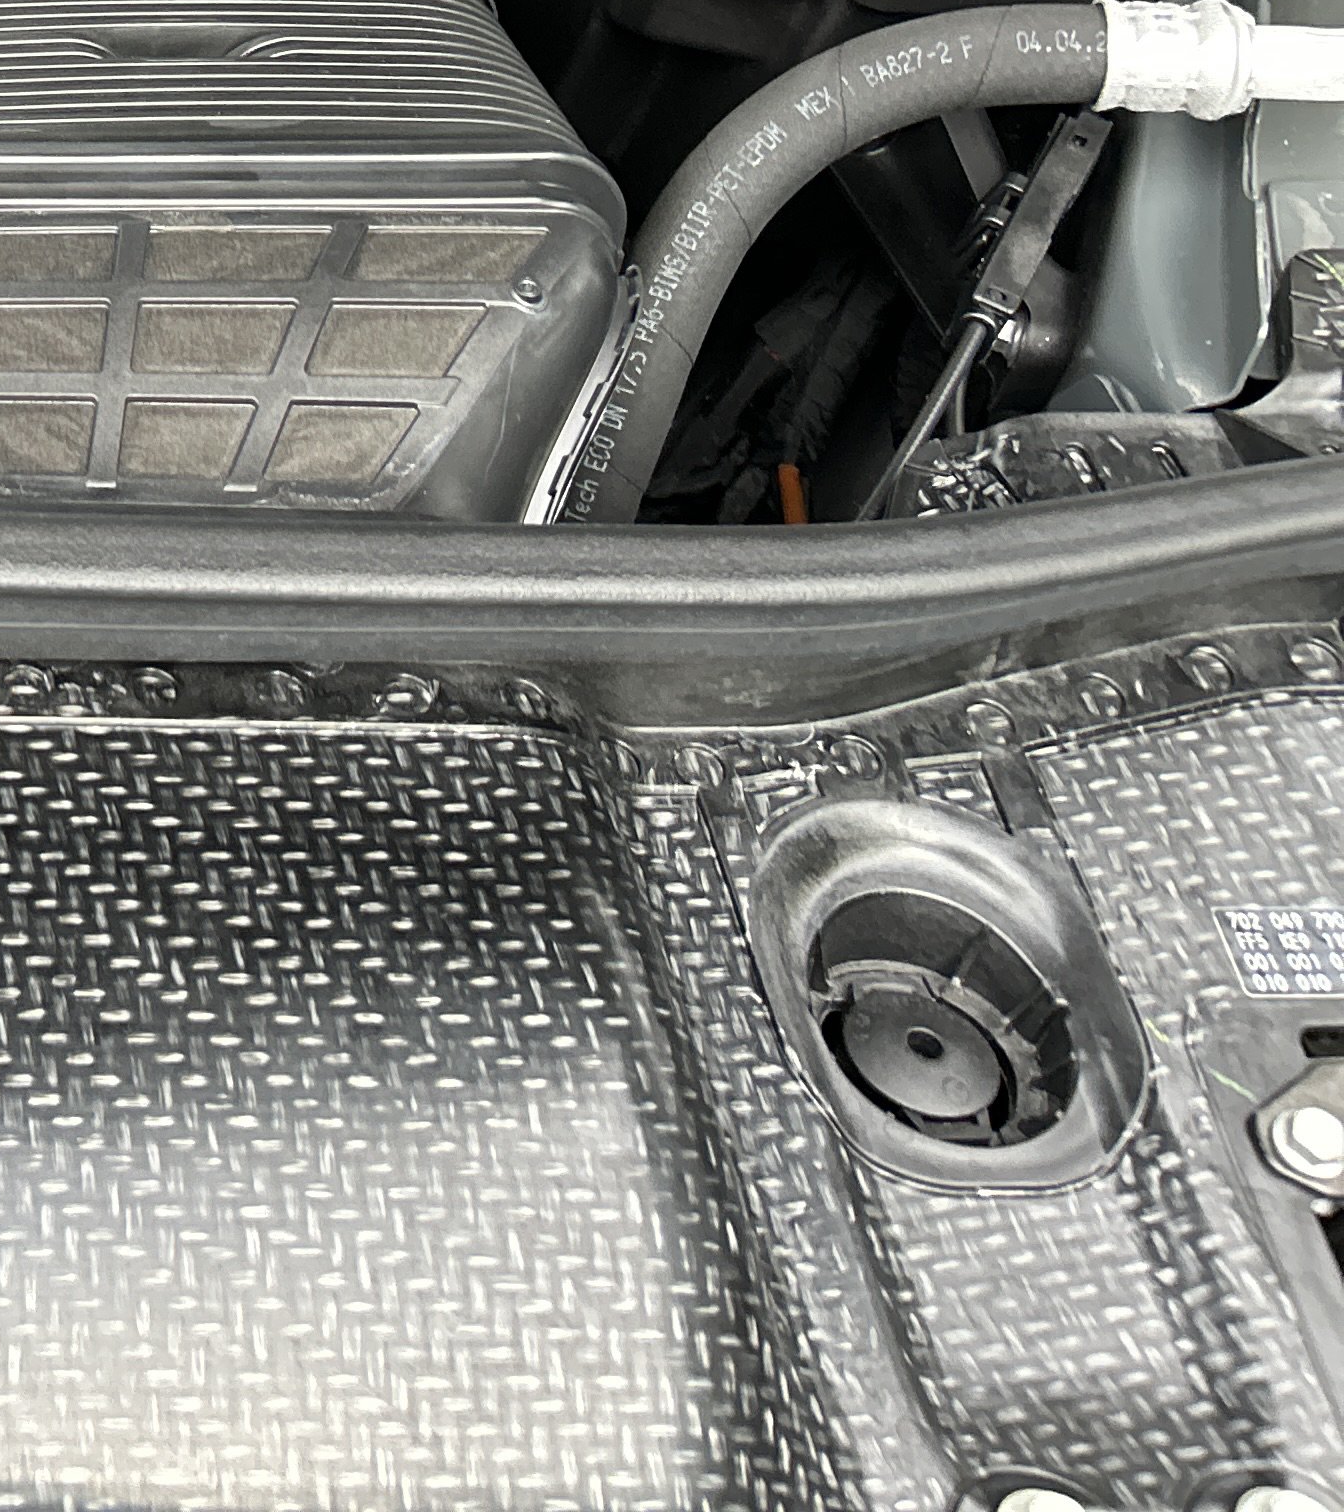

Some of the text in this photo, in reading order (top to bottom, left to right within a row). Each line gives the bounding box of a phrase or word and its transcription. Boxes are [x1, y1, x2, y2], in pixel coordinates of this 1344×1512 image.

[583, 435, 615, 474] ECO
[601, 404, 630, 431] DN
[794, 86, 839, 120] MEX
[961, 34, 973, 59] F
[1225, 911, 1264, 931] 702
[1243, 952, 1280, 972] 001
[1286, 952, 1321, 971] 001
[1252, 973, 1332, 992] 010 010
